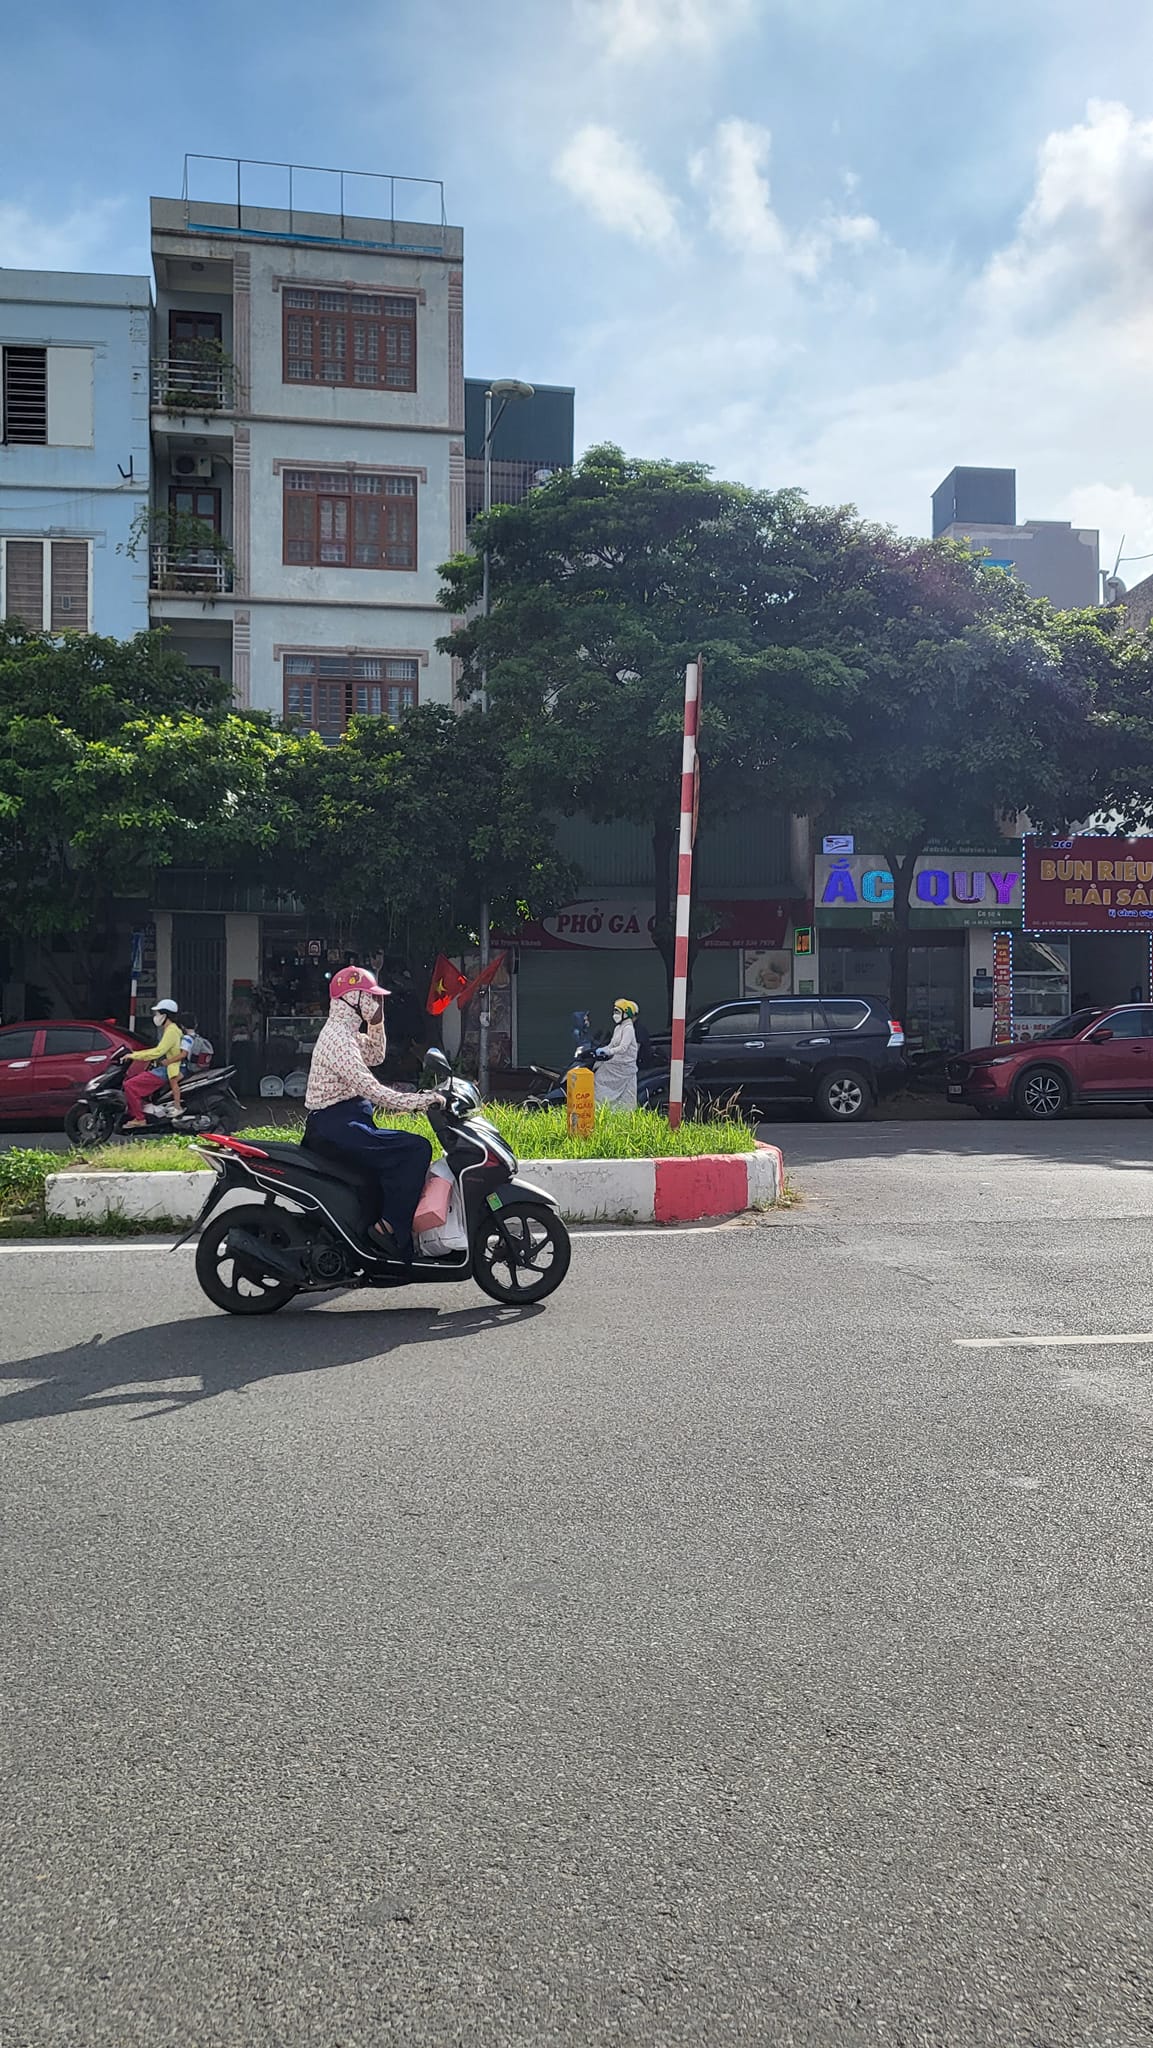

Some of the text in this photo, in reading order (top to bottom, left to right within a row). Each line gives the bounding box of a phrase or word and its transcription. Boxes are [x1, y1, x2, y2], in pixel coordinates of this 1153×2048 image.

[1040, 854, 1093, 881] BÚN
[821, 857, 1020, 906] ẮC QUY
[1065, 883, 1153, 906] HẢI SẢ
[556, 906, 605, 933] PHỞ
